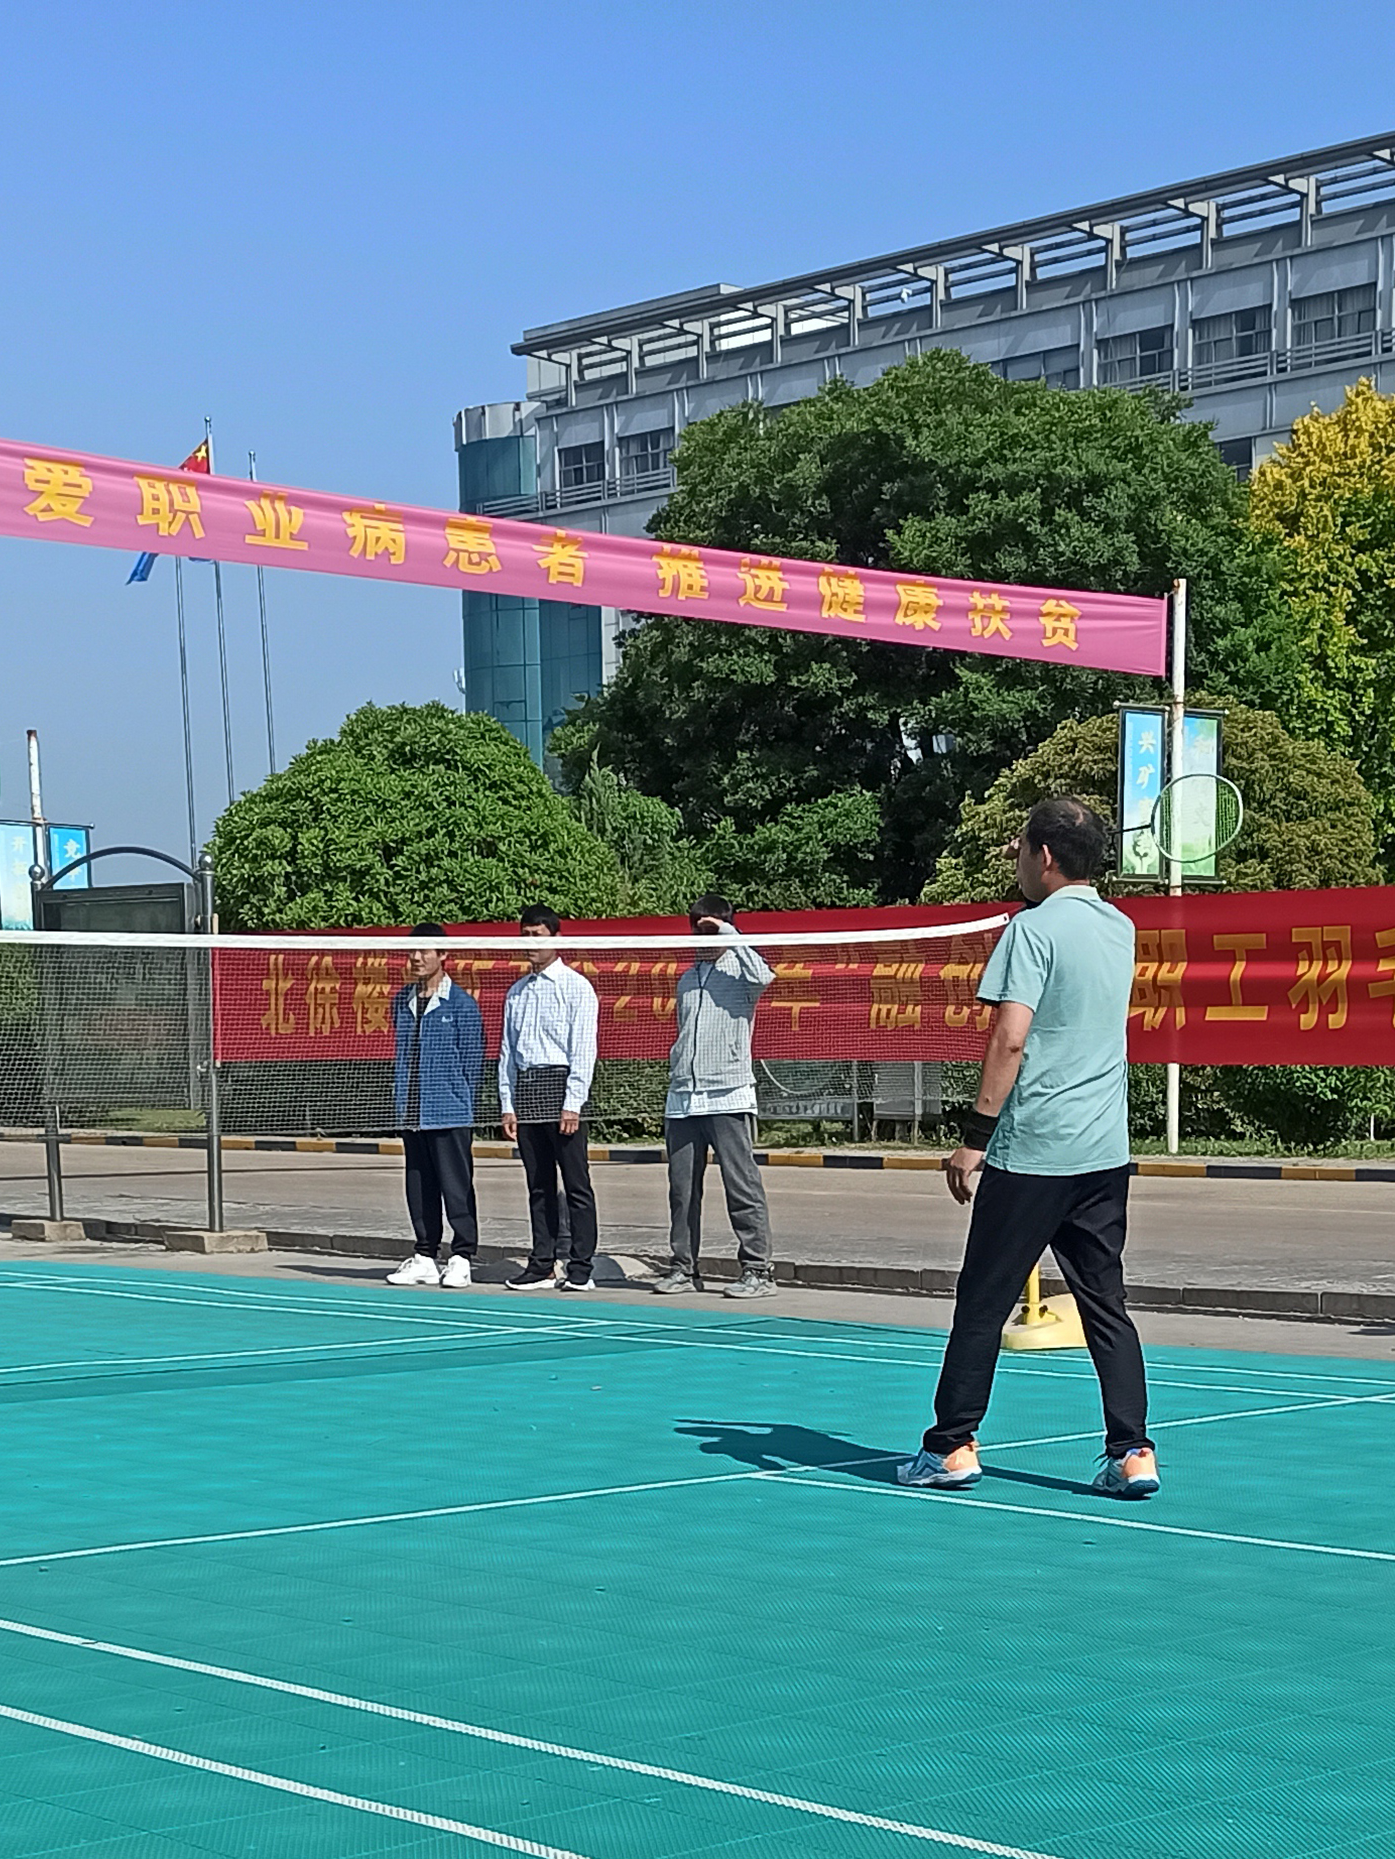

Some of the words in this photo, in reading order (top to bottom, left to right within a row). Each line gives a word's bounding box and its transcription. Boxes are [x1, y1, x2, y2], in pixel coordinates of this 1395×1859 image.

[652, 544, 1082, 651] 推进健康扶贫
